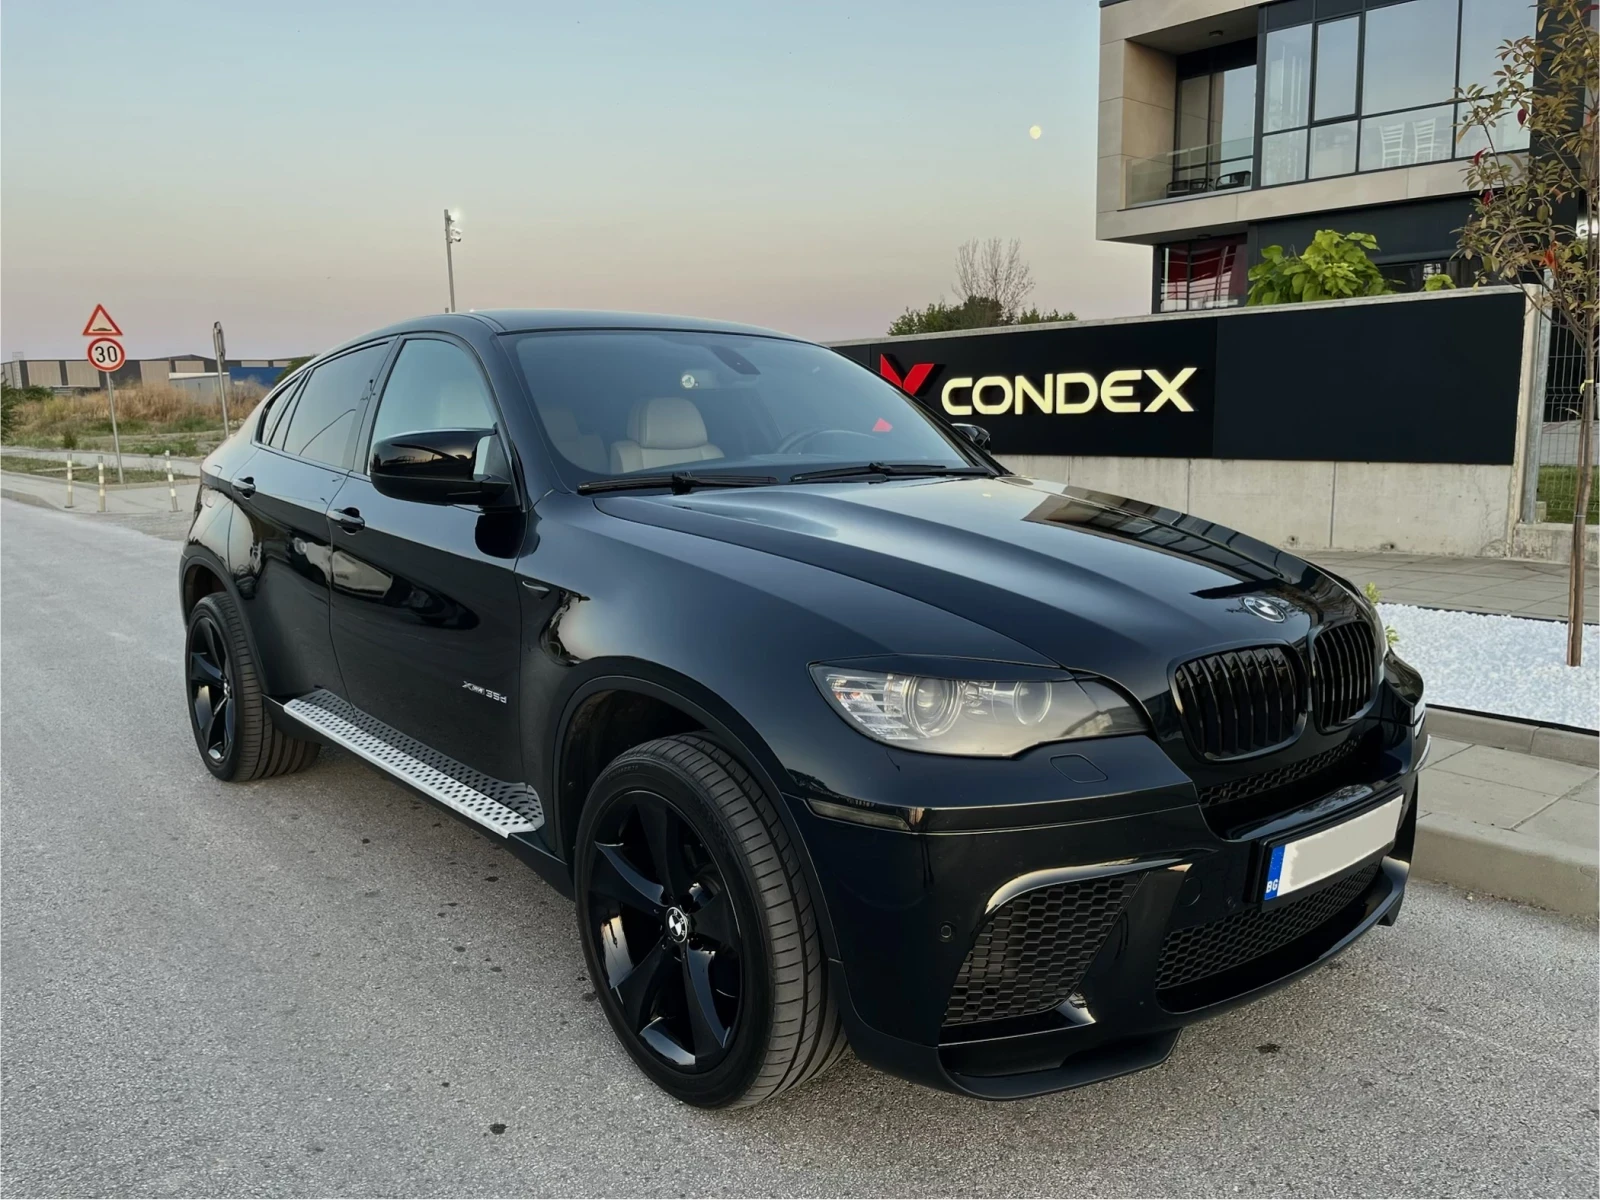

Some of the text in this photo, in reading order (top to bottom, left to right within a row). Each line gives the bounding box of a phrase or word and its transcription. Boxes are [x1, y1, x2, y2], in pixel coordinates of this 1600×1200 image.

[94, 345, 118, 363] 30
[941, 367, 1198, 416] CONDEX
[1266, 878, 1279, 894] BG
